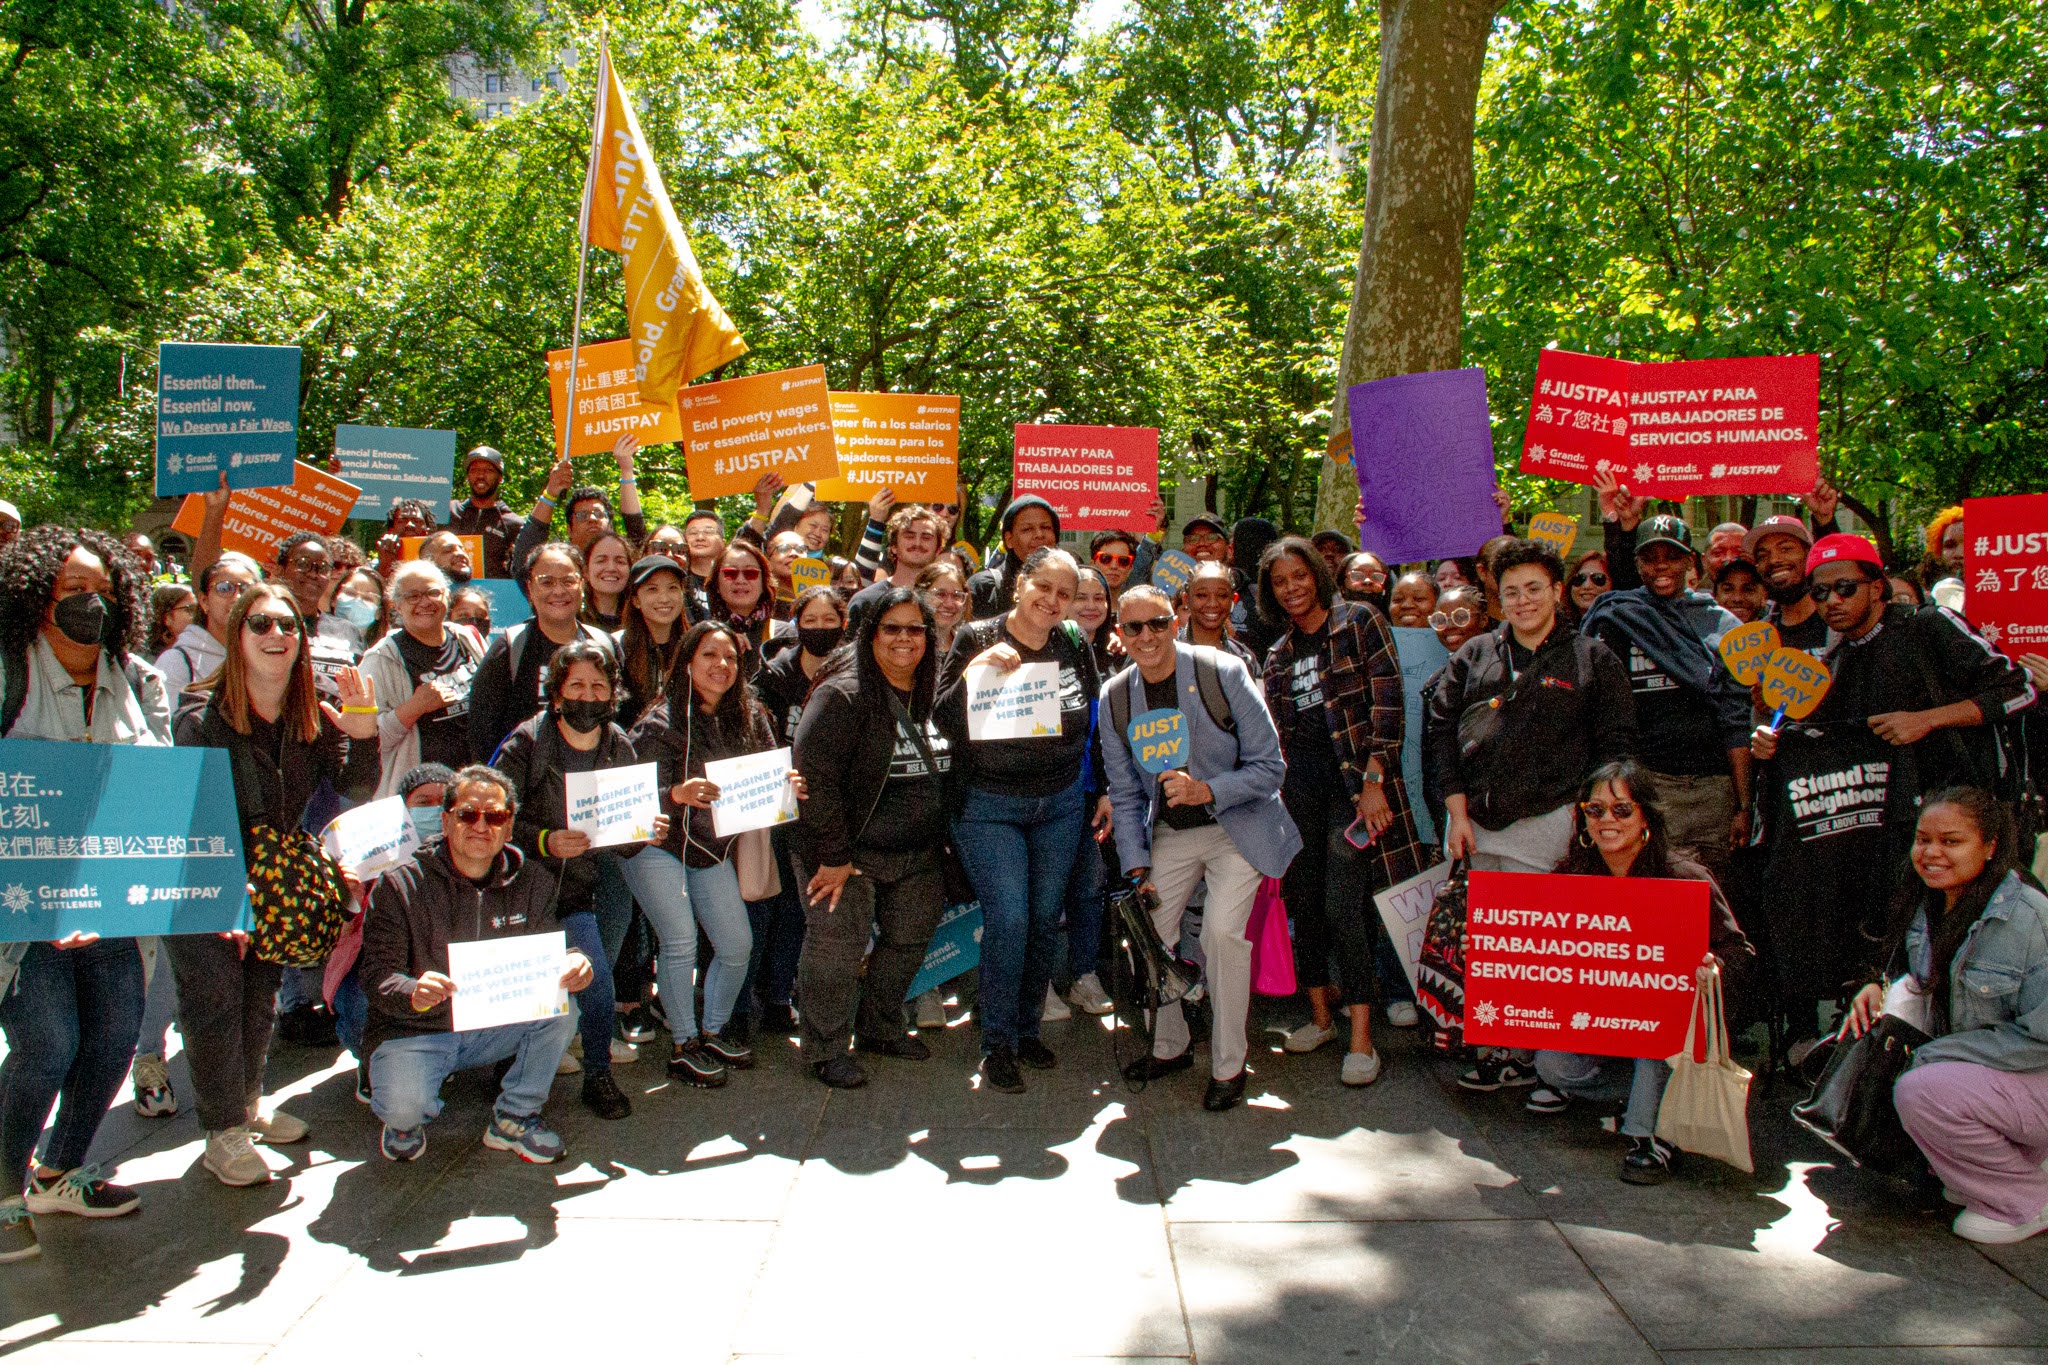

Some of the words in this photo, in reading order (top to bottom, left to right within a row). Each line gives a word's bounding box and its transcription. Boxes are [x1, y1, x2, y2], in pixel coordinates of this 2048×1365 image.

[635, 321, 668, 382] Bold.
[655, 262, 688, 313] Gran
[163, 374, 222, 391] Essential
[226, 374, 266, 390] then...
[781, 377, 822, 391] #JUSTPAY
[1630, 389, 1707, 405] #JUSTPAY
[1713, 387, 1757, 402] PARA
[162, 396, 221, 414] Essential
[224, 400, 256, 412] now.
[917, 405, 956, 414] #JUSTPAY
[585, 411, 661, 436] #JUSTPAY
[693, 417, 718, 432] End
[722, 410, 772, 431] poverty
[776, 402, 818, 418] wages
[832, 419, 859, 428] oner
[862, 417, 876, 428] fin
[880, 420, 887, 428] a
[890, 418, 906, 430] los
[909, 419, 951, 430] salarios
[1630, 408, 1756, 425] TRABAJADORES
[1761, 407, 1783, 420] DE
[161, 421, 181, 434] We
[183, 420, 227, 433] Deserve
[230, 422, 237, 432] a
[239, 419, 259, 431] Fair
[261, 418, 293, 433] Wage.
[690, 440, 710, 452] for
[713, 430, 770, 449] essential
[773, 420, 830, 438] workers.
[850, 434, 896, 447] pobreza
[900, 438, 925, 448] para
[928, 436, 944, 447] los
[1629, 431, 1712, 446] SERVICIOS
[1716, 428, 1808, 443] HUMANOS.
[185, 453, 213, 464] Grand
[230, 453, 282, 467] #JUSTPAY
[335, 448, 370, 457] Esencial
[372, 449, 419, 460] Entonces...
[714, 444, 810, 475] #JUSTPAY
[837, 452, 892, 465] bajadores
[895, 453, 955, 465] esenciales.
[1018, 446, 1078, 458] #JUSTPAY
[1081, 448, 1114, 459] PARA
[1549, 448, 1580, 462] Grand
[340, 460, 369, 468] sencial
[371, 460, 400, 470] Ahora.
[1018, 463, 1113, 475] TRABAJADORES
[1116, 465, 1133, 476] DE
[1548, 458, 1588, 471] SETTLEMENT
[1657, 463, 1692, 474] Grand
[1710, 463, 1781, 478] #JUSTPAY
[404, 474, 427, 482] Salario
[847, 470, 927, 485] #JUSTPAY
[1017, 478, 1080, 491] SERVICIOS
[1083, 480, 1151, 493] HUMANOS.
[281, 485, 298, 497] los
[299, 494, 342, 516] salarios
[229, 501, 269, 522] adores
[281, 505, 309, 520] para
[310, 513, 328, 528] los
[1078, 506, 1131, 517] #JUSTPAY
[222, 518, 285, 547] JUSTPA
[1533, 519, 1573, 536] JUST
[793, 564, 828, 580] JUST
[1163, 554, 1191, 575] JUS
[1725, 628, 1772, 656] JUST
[313, 663, 326, 672] OVE
[1737, 650, 1774, 674] PAY
[1773, 656, 1828, 687] JUST
[976, 682, 1032, 700] IMAGINE
[1034, 680, 1048, 690] IF
[1647, 678, 1665, 688] RISE
[1768, 678, 1812, 704] PAY
[971, 701, 992, 712] WE
[994, 690, 1056, 708] WEREN'T
[1311, 691, 1324, 702] ABO
[996, 707, 1034, 720] HERE
[1132, 714, 1182, 741] JUST
[1142, 737, 1183, 762] PAY
[906, 763, 919, 774] RISE
[721, 771, 771, 794] MAGINE
[772, 766, 784, 779] IF
[1788, 764, 1864, 801] Stand
[576, 786, 631, 809] IMAGINE
[633, 781, 646, 793] IF
[715, 795, 735, 808] WE
[571, 808, 594, 822] WE
[595, 792, 654, 817] WEREN'T
[740, 795, 775, 813] HERE
[596, 811, 632, 828] HERE
[1832, 815, 1858, 829] ABOVE
[1859, 812, 1879, 823] HATE
[38, 884, 89, 899] Grand
[127, 884, 222, 905] #JUSTPAY
[41, 900, 101, 910] SETTLEMEN
[1472, 907, 1570, 929] #JUSTPAY
[1576, 913, 1632, 932] PARA
[1471, 934, 1630, 960] TRABAJADORES
[1636, 945, 1665, 962] DE
[462, 959, 535, 982] IMAGINE
[1471, 961, 1573, 984] SERVICIOS
[1579, 968, 1695, 992] HUMANOS.
[488, 987, 536, 1003] HERE
[1503, 1004, 1546, 1019] Grand
[1504, 1018, 1561, 1030] SETTLEMENT
[1570, 1012, 1660, 1032] #JUSTPAY
